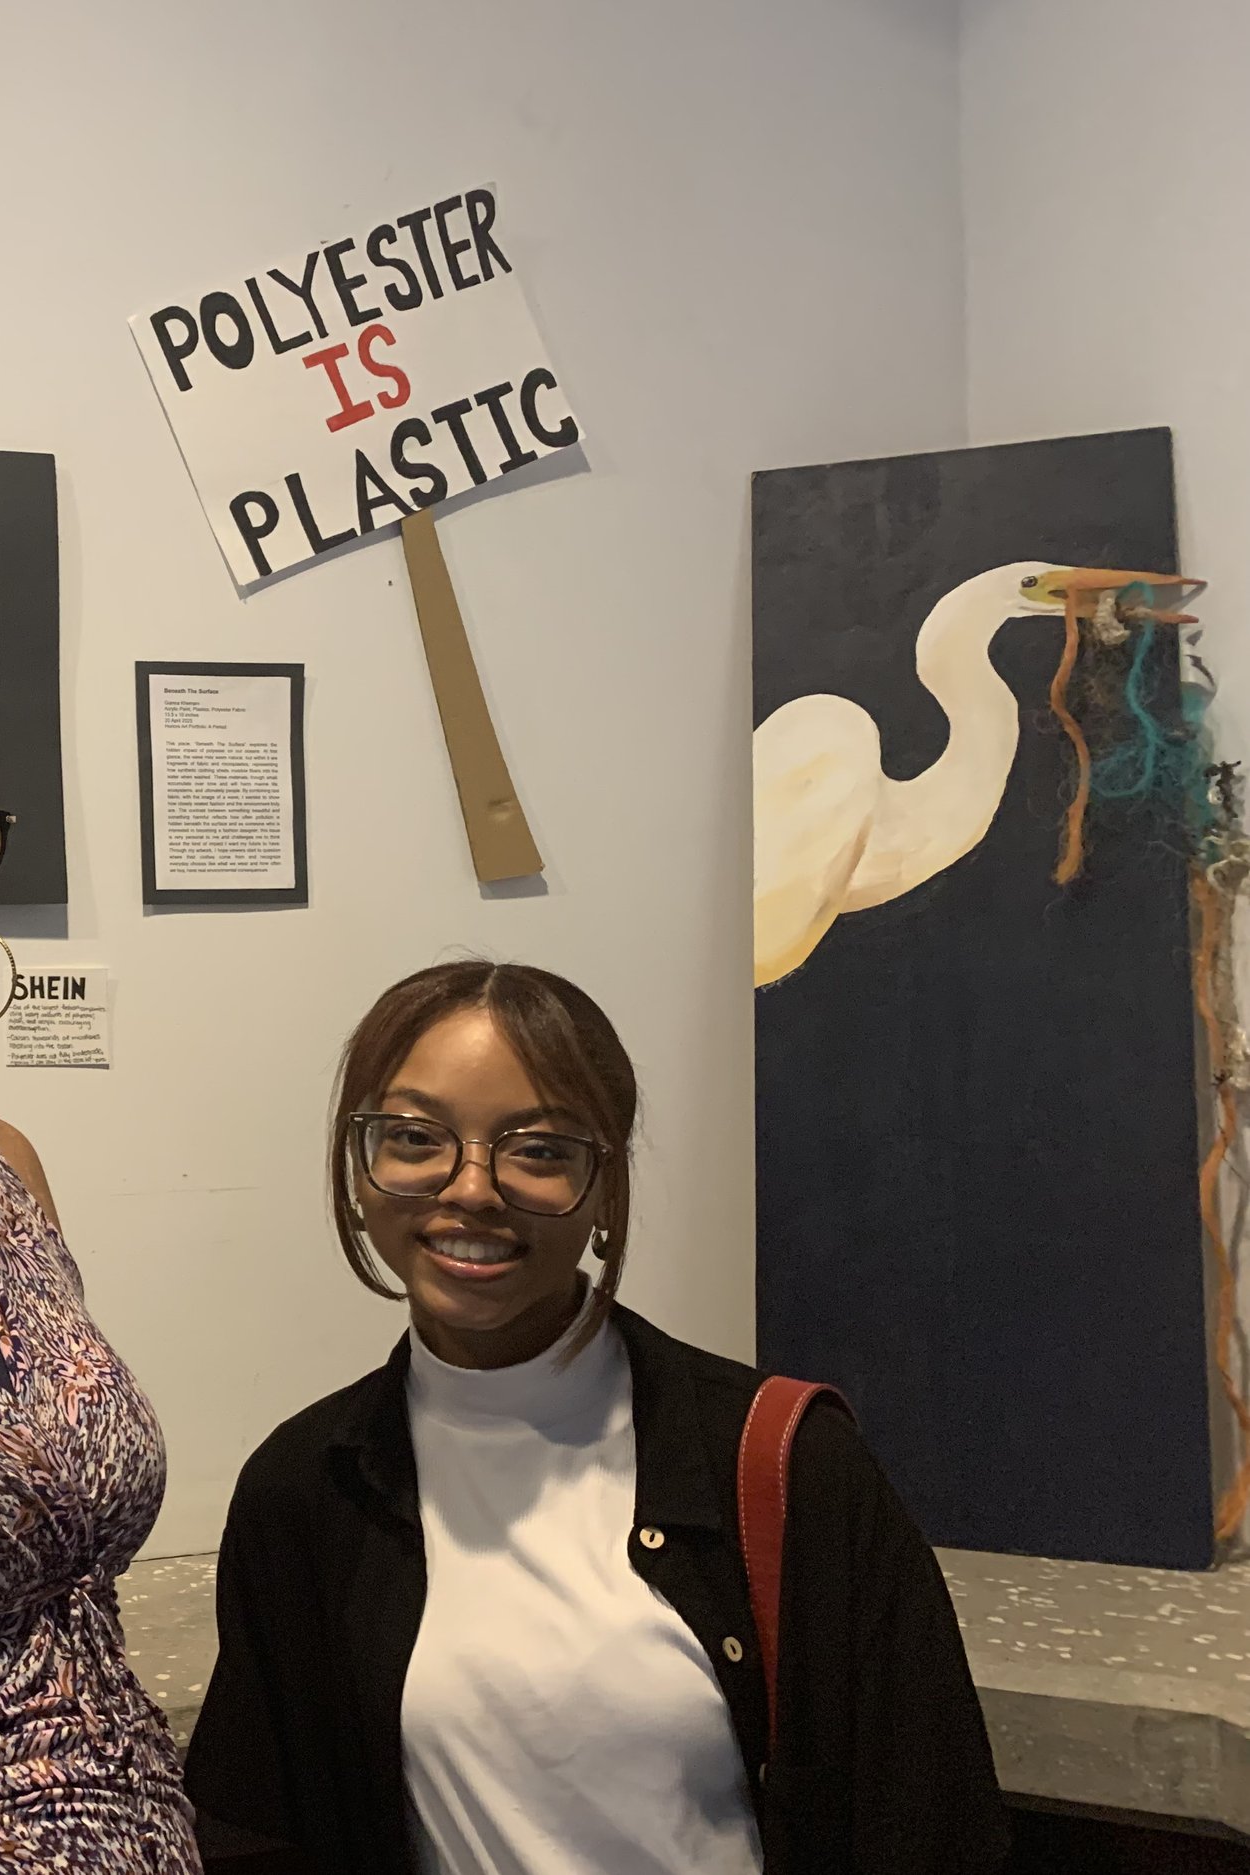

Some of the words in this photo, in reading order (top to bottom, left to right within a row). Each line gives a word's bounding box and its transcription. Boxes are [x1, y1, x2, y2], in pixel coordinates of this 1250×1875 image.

[150, 189, 513, 392] POLYESTER
[302, 324, 411, 433] IS
[229, 368, 579, 577] PLASTIC
[13, 974, 86, 1000] SHEIN
